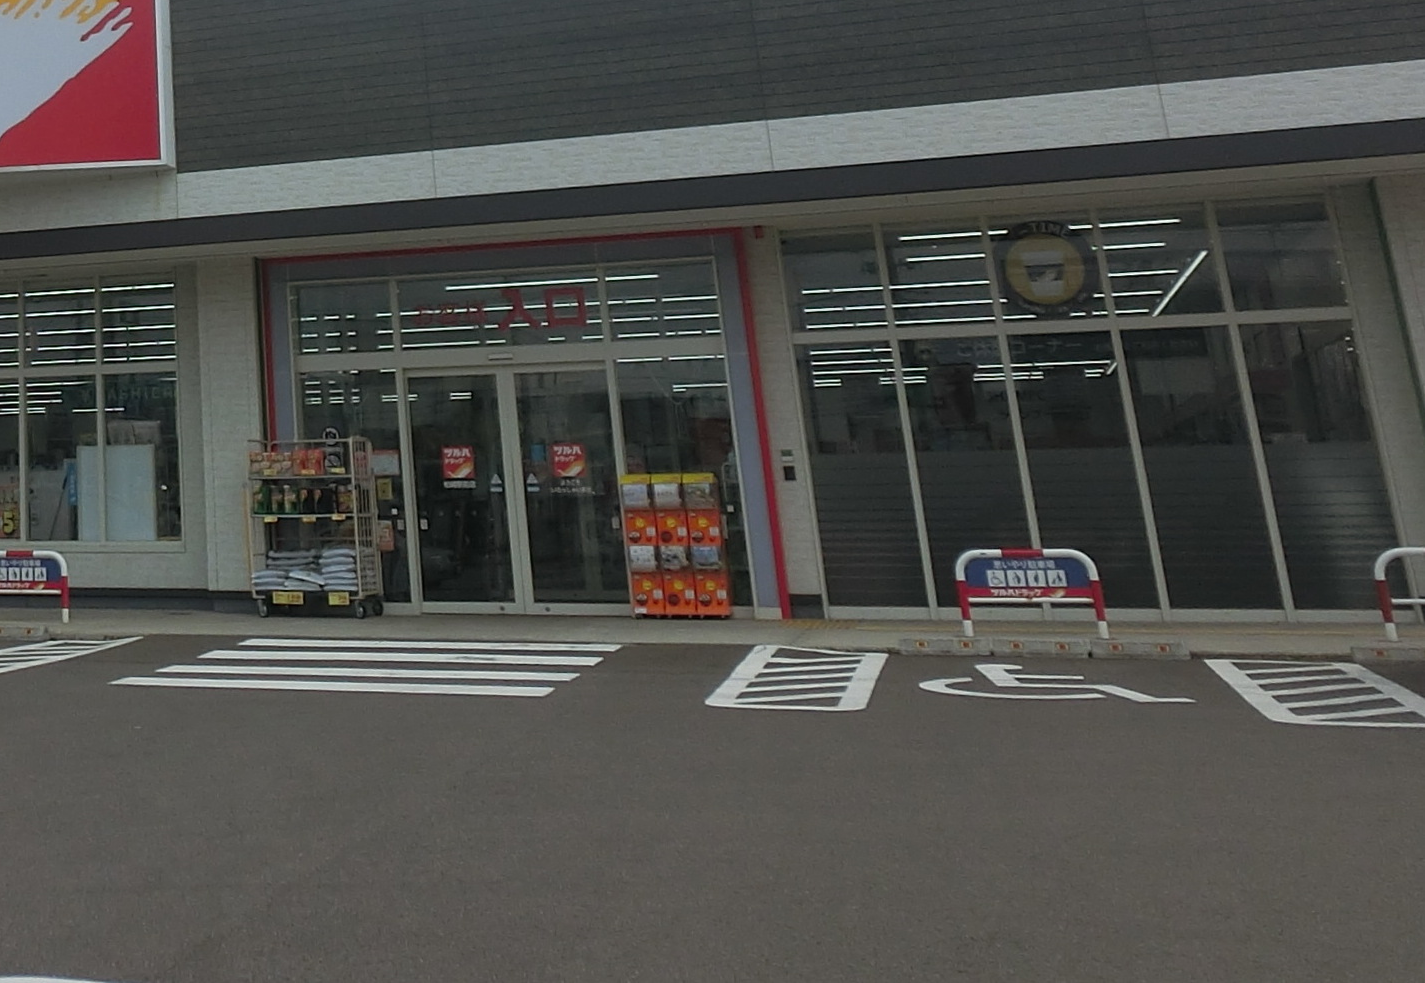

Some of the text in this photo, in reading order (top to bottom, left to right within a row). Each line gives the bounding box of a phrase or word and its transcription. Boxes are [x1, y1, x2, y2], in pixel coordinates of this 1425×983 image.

[498, 288, 587, 331] 入口
[443, 448, 471, 458] ツルハ
[553, 446, 582, 455] ツルハ
